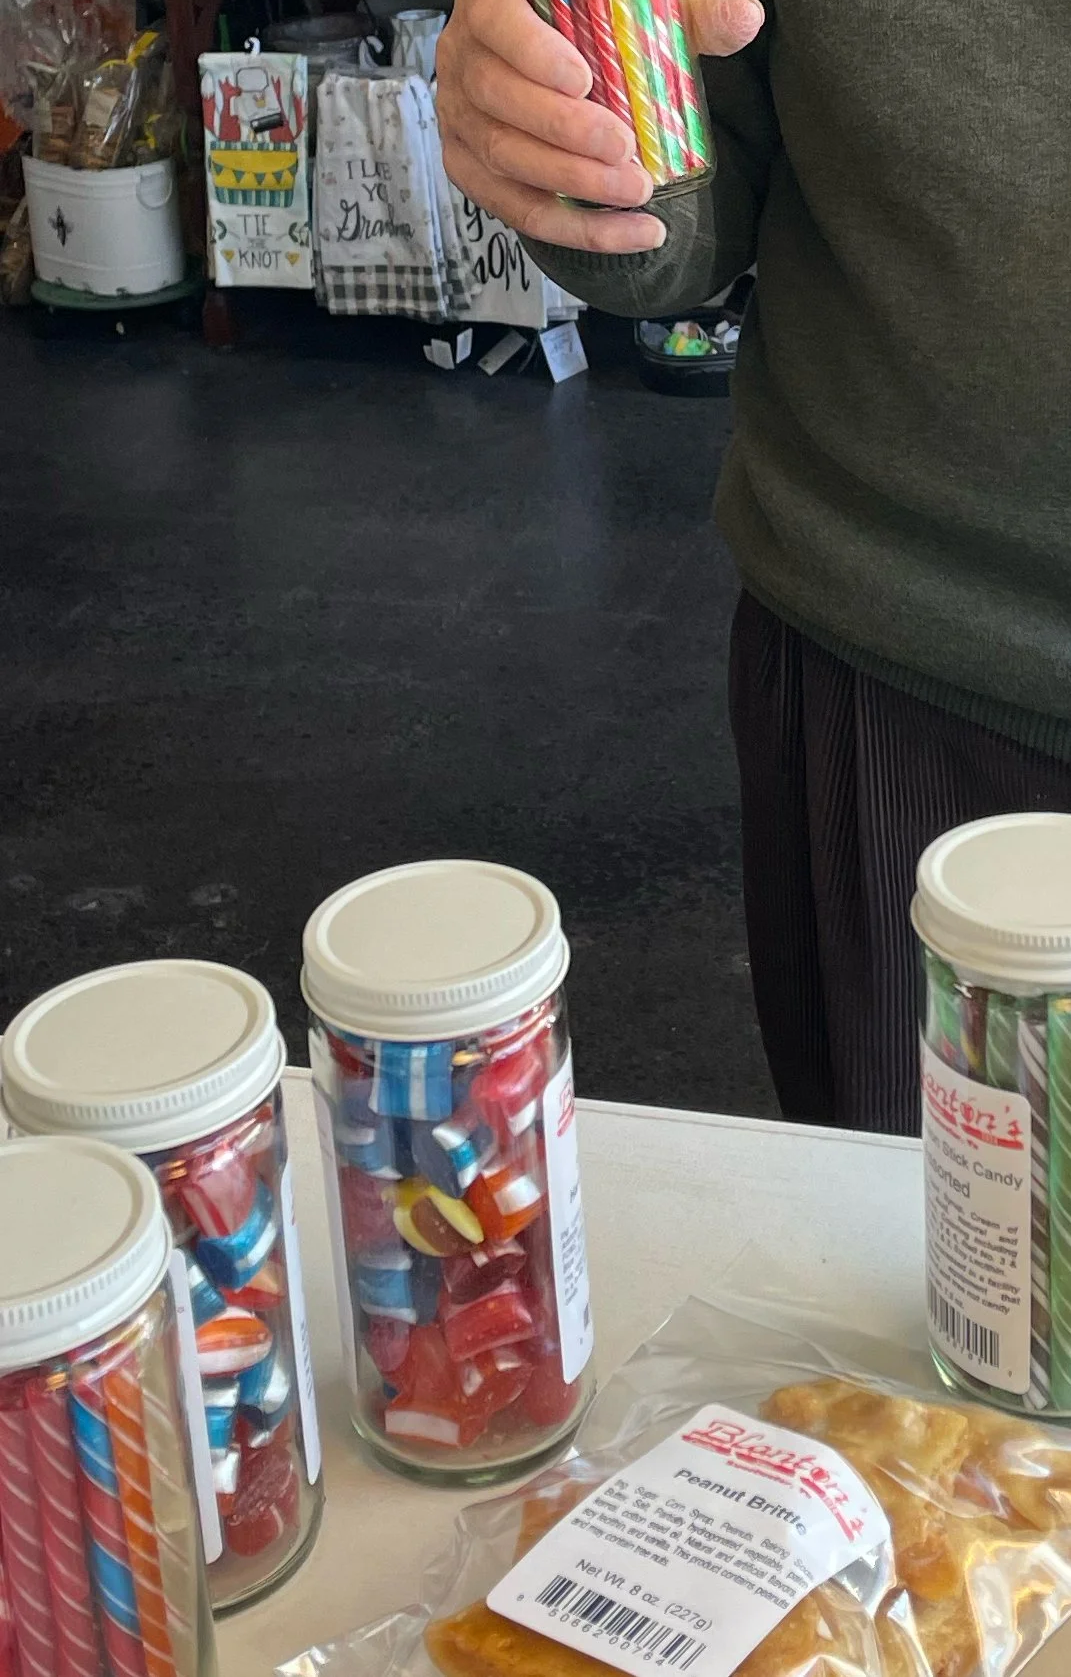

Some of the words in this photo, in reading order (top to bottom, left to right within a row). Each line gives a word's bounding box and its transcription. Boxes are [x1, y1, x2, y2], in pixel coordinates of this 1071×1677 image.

[236, 213, 272, 236] TIE
[238, 248, 282, 270] KNOT
[973, 1161, 1023, 1191] Candy
[690, 1420, 866, 1536] Blanton's
[673, 1467, 746, 1504] Peanut
[746, 1495, 807, 1536] Brittle
[673, 1545, 691, 1560] This
[687, 1555, 722, 1574] product
[720, 1569, 756, 1591] contains
[575, 1558, 602, 1578] Net
[604, 1570, 626, 1589] Wt.
[629, 1584, 642, 1596] 8
[664, 1602, 713, 1632] (227g)
